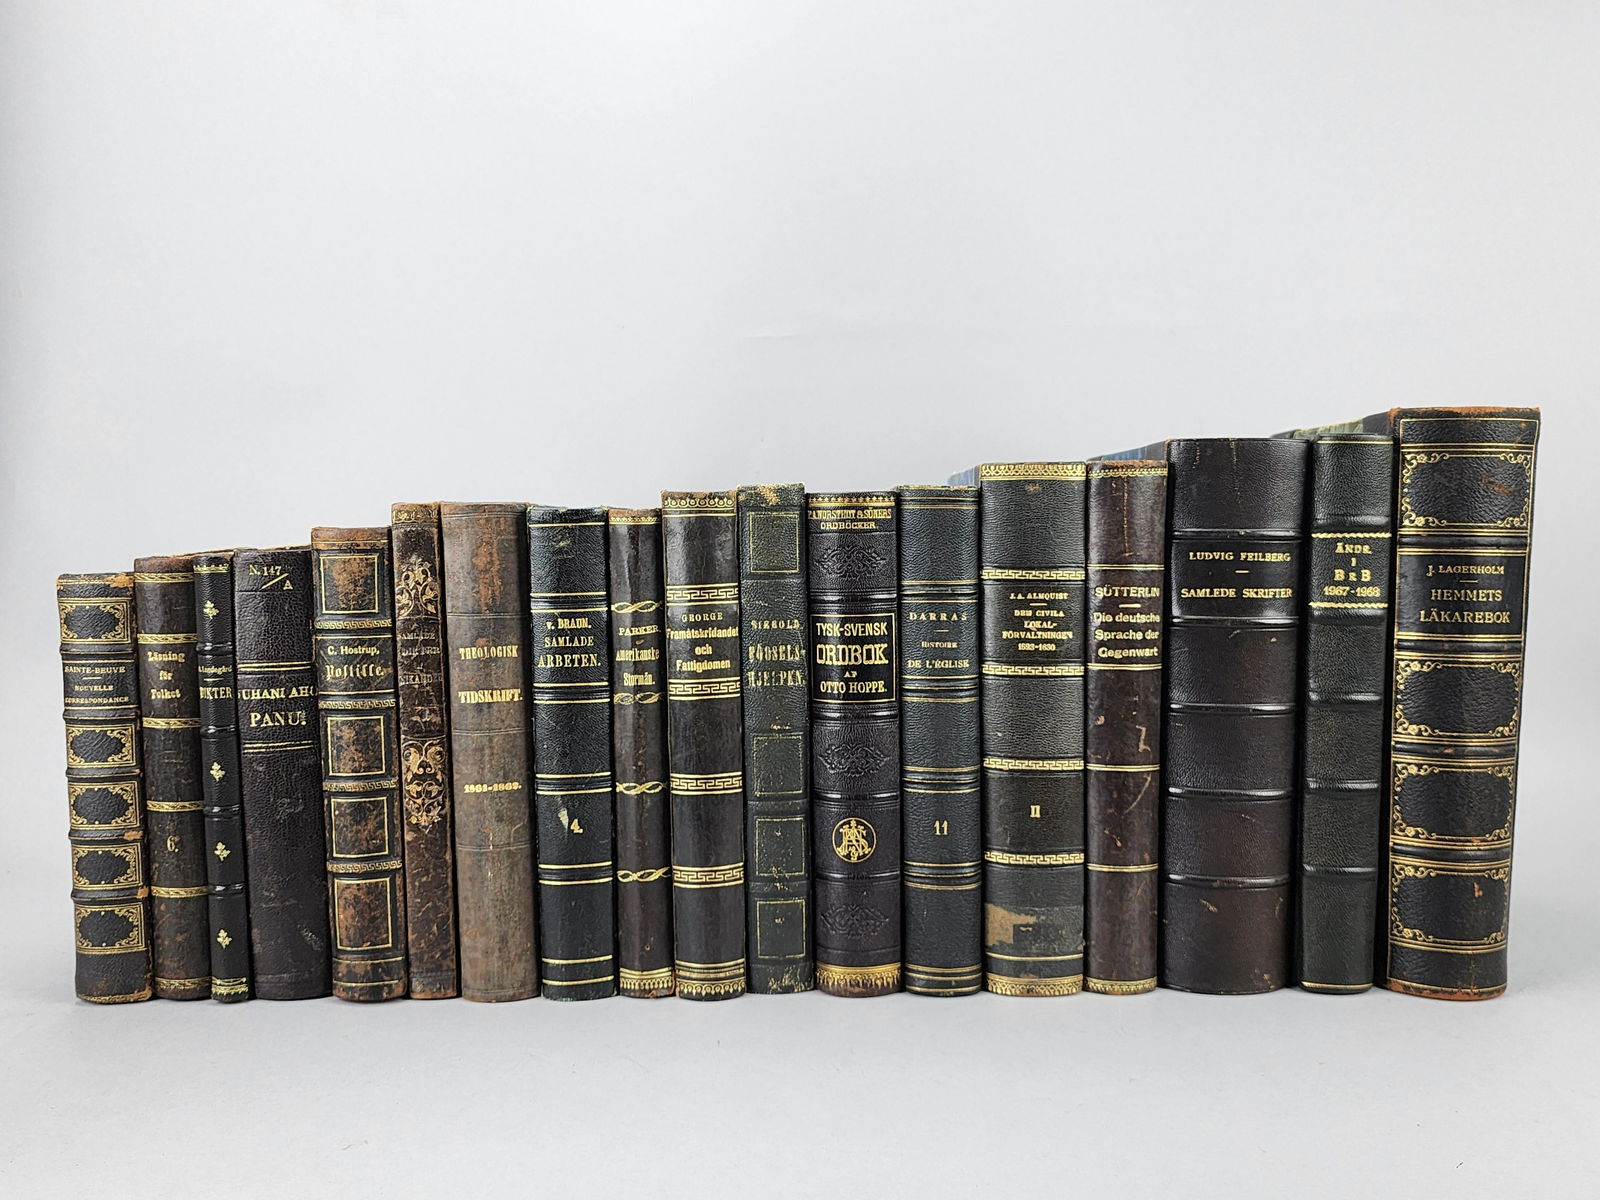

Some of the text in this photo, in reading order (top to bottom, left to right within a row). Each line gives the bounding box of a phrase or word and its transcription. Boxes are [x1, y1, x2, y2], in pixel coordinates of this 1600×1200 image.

[1188, 551, 1292, 562] LUDVIG FEILBERG
[1438, 565, 1505, 575] LAGERHOLM
[1094, 584, 1160, 598] SÜTTERLIN
[1180, 588, 1293, 598] SAMLEDE SKRIFTER
[1430, 588, 1503, 602] HEMMETS
[681, 612, 724, 623] GEORGE
[909, 612, 968, 621] DARRAS
[1035, 609, 1065, 617] CIVILA
[1093, 611, 1160, 623] Die deutsche
[1419, 608, 1511, 623] LÄKAREBOK
[815, 622, 888, 637] TYSK-SVENSK
[1094, 629, 1159, 641] Sprache der
[544, 635, 595, 648] SAMLADE
[694, 643, 713, 656] och
[816, 643, 889, 666] ORDBOK
[1097, 646, 1159, 659] Gegenwart
[537, 653, 602, 668] ARBETEN.
[675, 659, 731, 673] Fattigdomen
[907, 660, 922, 668] DE
[820, 681, 888, 694] OTTO HOPPE.
